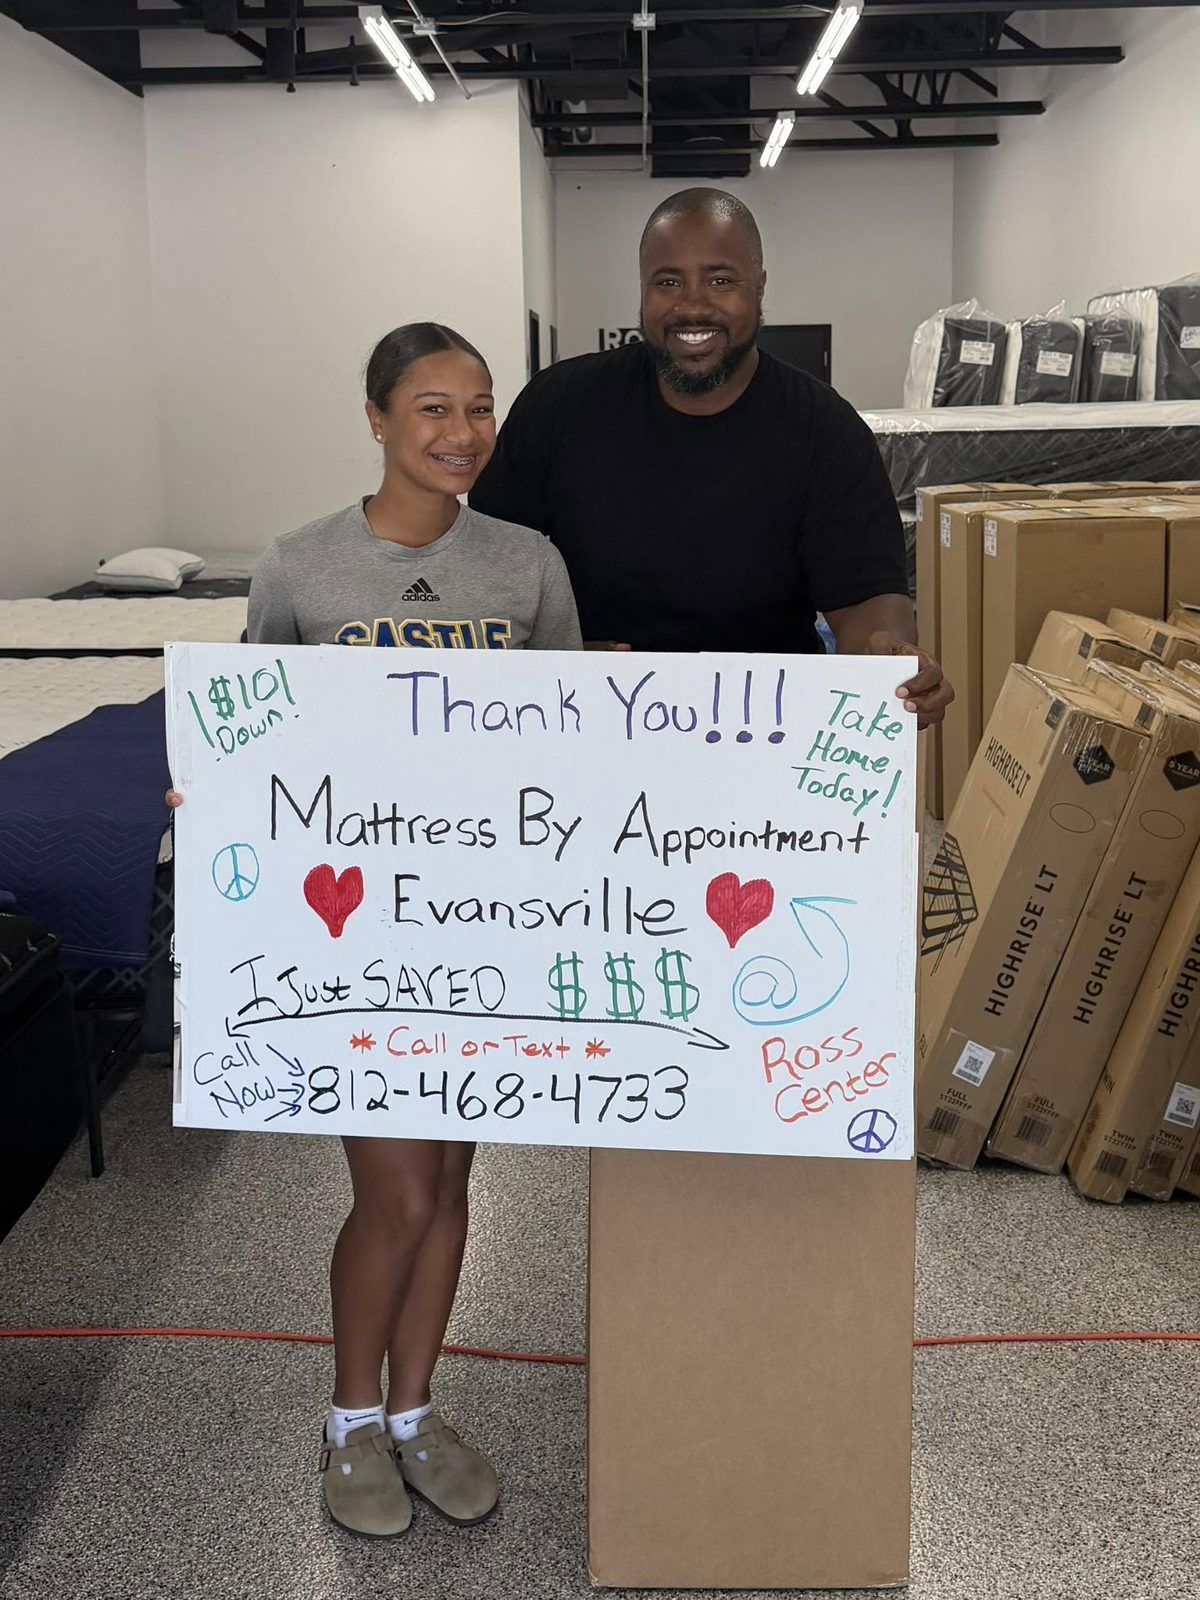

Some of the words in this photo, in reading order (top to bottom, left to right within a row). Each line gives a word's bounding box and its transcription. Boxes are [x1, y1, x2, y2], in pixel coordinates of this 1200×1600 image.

[401, 593, 440, 602] adidas
[386, 671, 581, 736] Thank
[606, 669, 786, 744] You!!!
[829, 689, 904, 742] Take
[806, 730, 889, 774] Home
[1176, 761, 1200, 778] YEAR
[791, 766, 903, 819] Today!
[270, 774, 498, 849] Mattress
[519, 786, 583, 862] By
[613, 790, 870, 866] Appointment
[394, 873, 688, 936] Evansville
[984, 900, 1046, 1016] HIGHRISE
[1034, 863, 1059, 894] LT
[1073, 907, 1134, 1024] HIGHRISE
[1123, 870, 1148, 901] LT
[276, 966, 352, 1018] Just
[362, 959, 506, 1012] SAVED
[1158, 932, 1200, 1038] HIGHRI
[193, 1041, 261, 1086] Call
[386, 1025, 447, 1058] Call
[461, 1041, 499, 1058] or
[502, 1034, 571, 1060] Text
[761, 1026, 863, 1084] Ross
[209, 1076, 277, 1118] Now
[307, 1065, 689, 1125] 812-468-4733
[774, 1052, 897, 1124] Center
[946, 1087, 968, 1102] FULL
[1034, 1095, 1056, 1110] FULL
[1111, 1128, 1136, 1143] TWIN
[1158, 1128, 1183, 1143] TWIN
